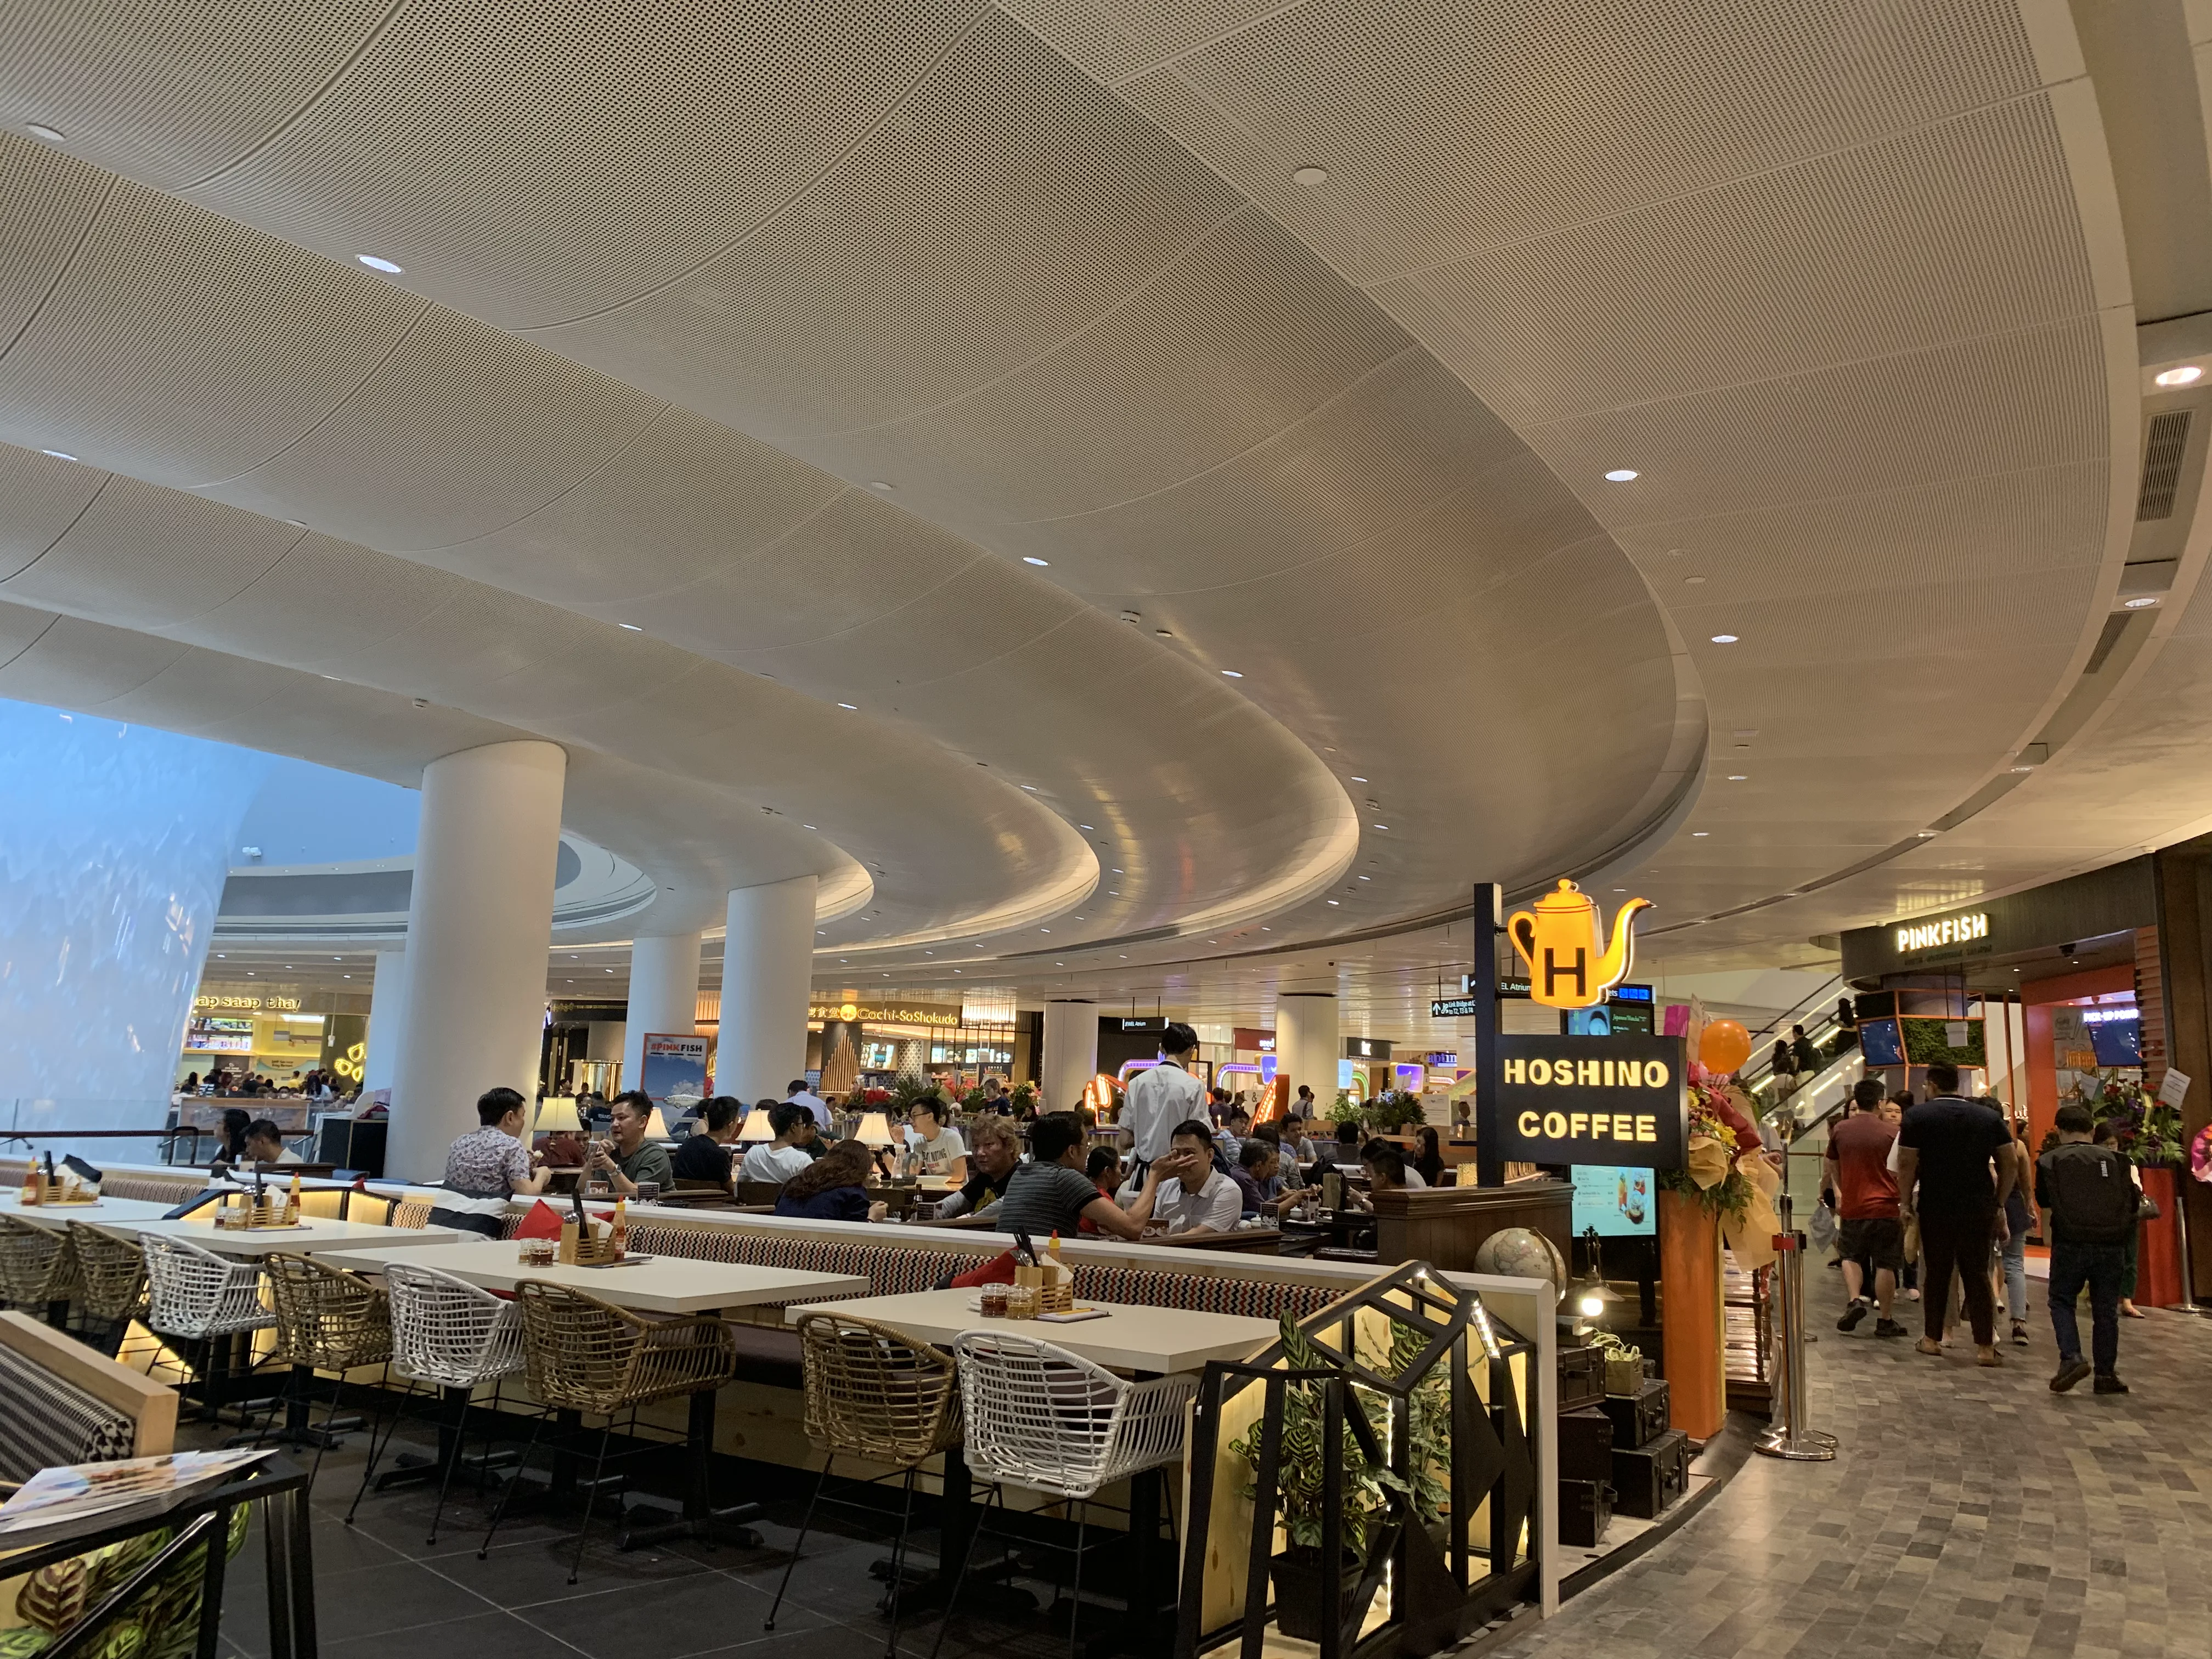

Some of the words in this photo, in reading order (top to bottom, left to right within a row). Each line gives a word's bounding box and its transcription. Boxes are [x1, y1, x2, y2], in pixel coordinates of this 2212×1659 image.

[1544, 947, 1586, 996] H
[222, 996, 261, 1009] saap
[1504, 1059, 1669, 1088] HOSHINO
[1518, 1111, 1657, 1142] COFFEE
